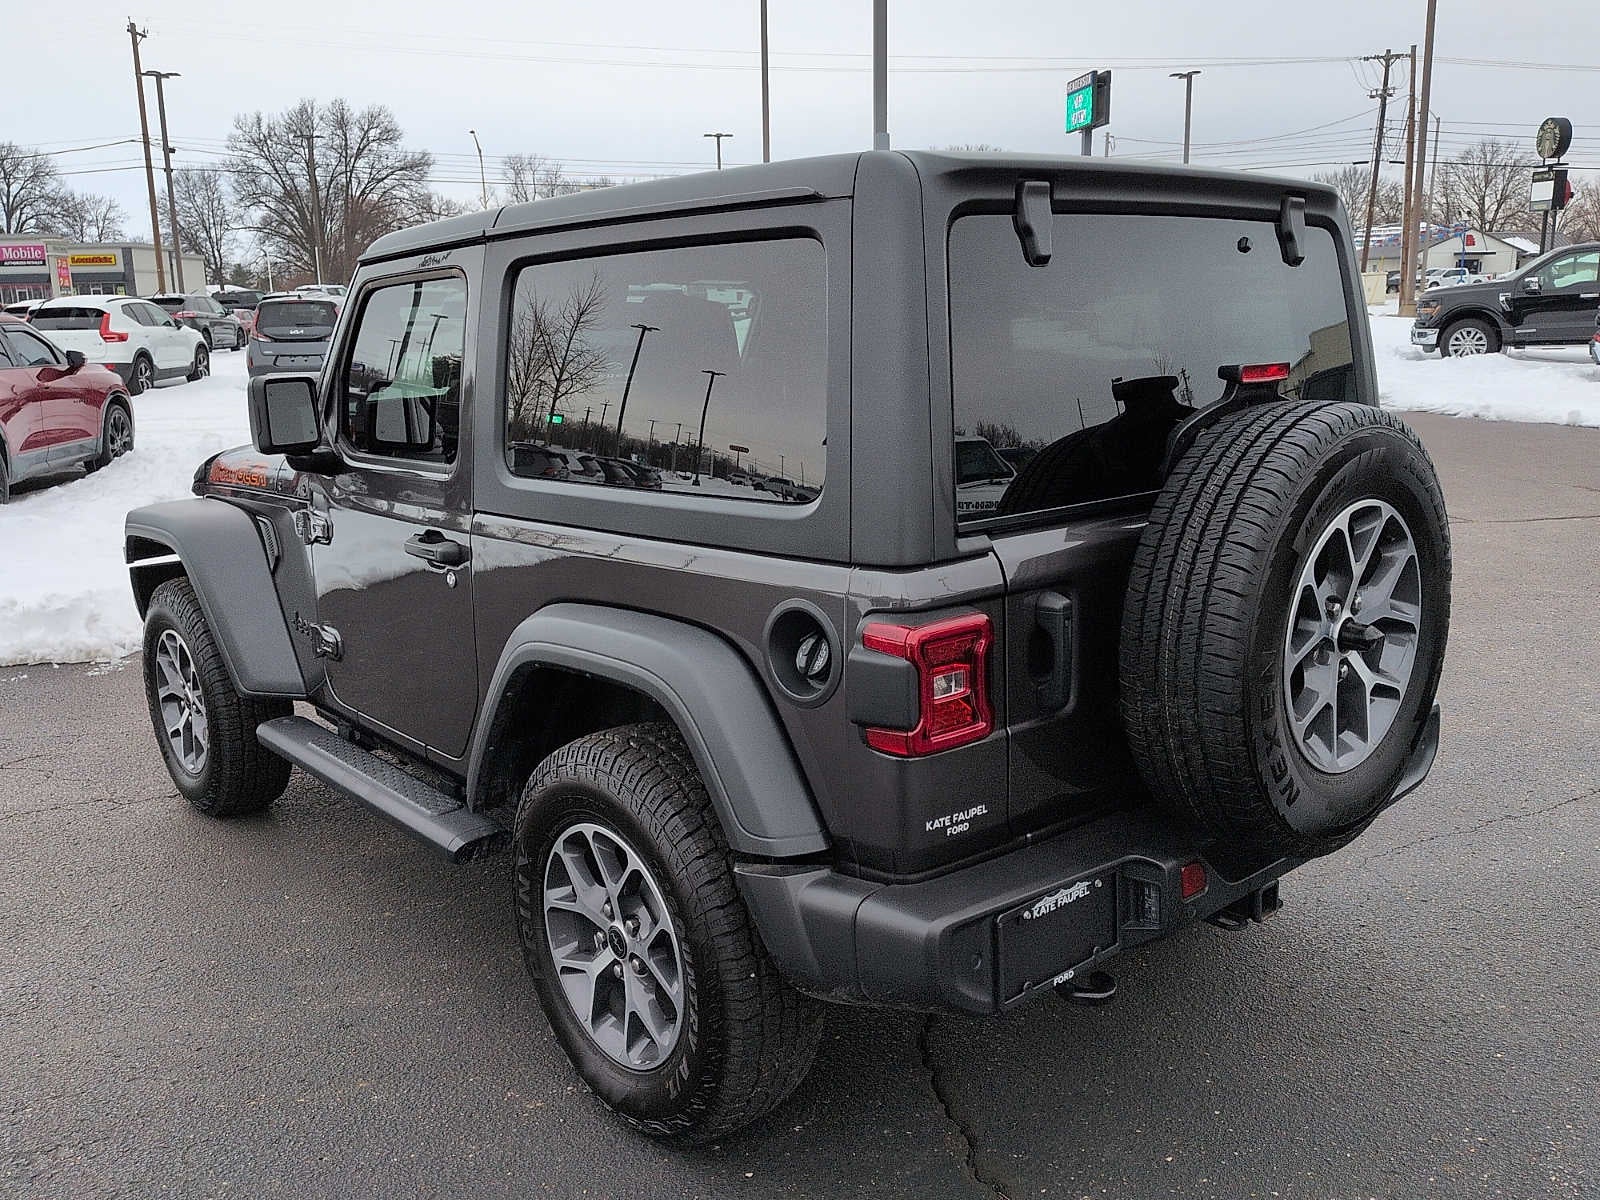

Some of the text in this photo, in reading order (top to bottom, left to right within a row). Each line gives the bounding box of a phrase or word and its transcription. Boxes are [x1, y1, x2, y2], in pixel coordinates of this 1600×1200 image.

[2, 247, 42, 259] Mobile
[925, 804, 988, 831] KATE FAUPEL
[946, 822, 970, 837] FORD
[1032, 886, 1090, 919] KATE FAUPEL
[1053, 970, 1075, 987] FORD
